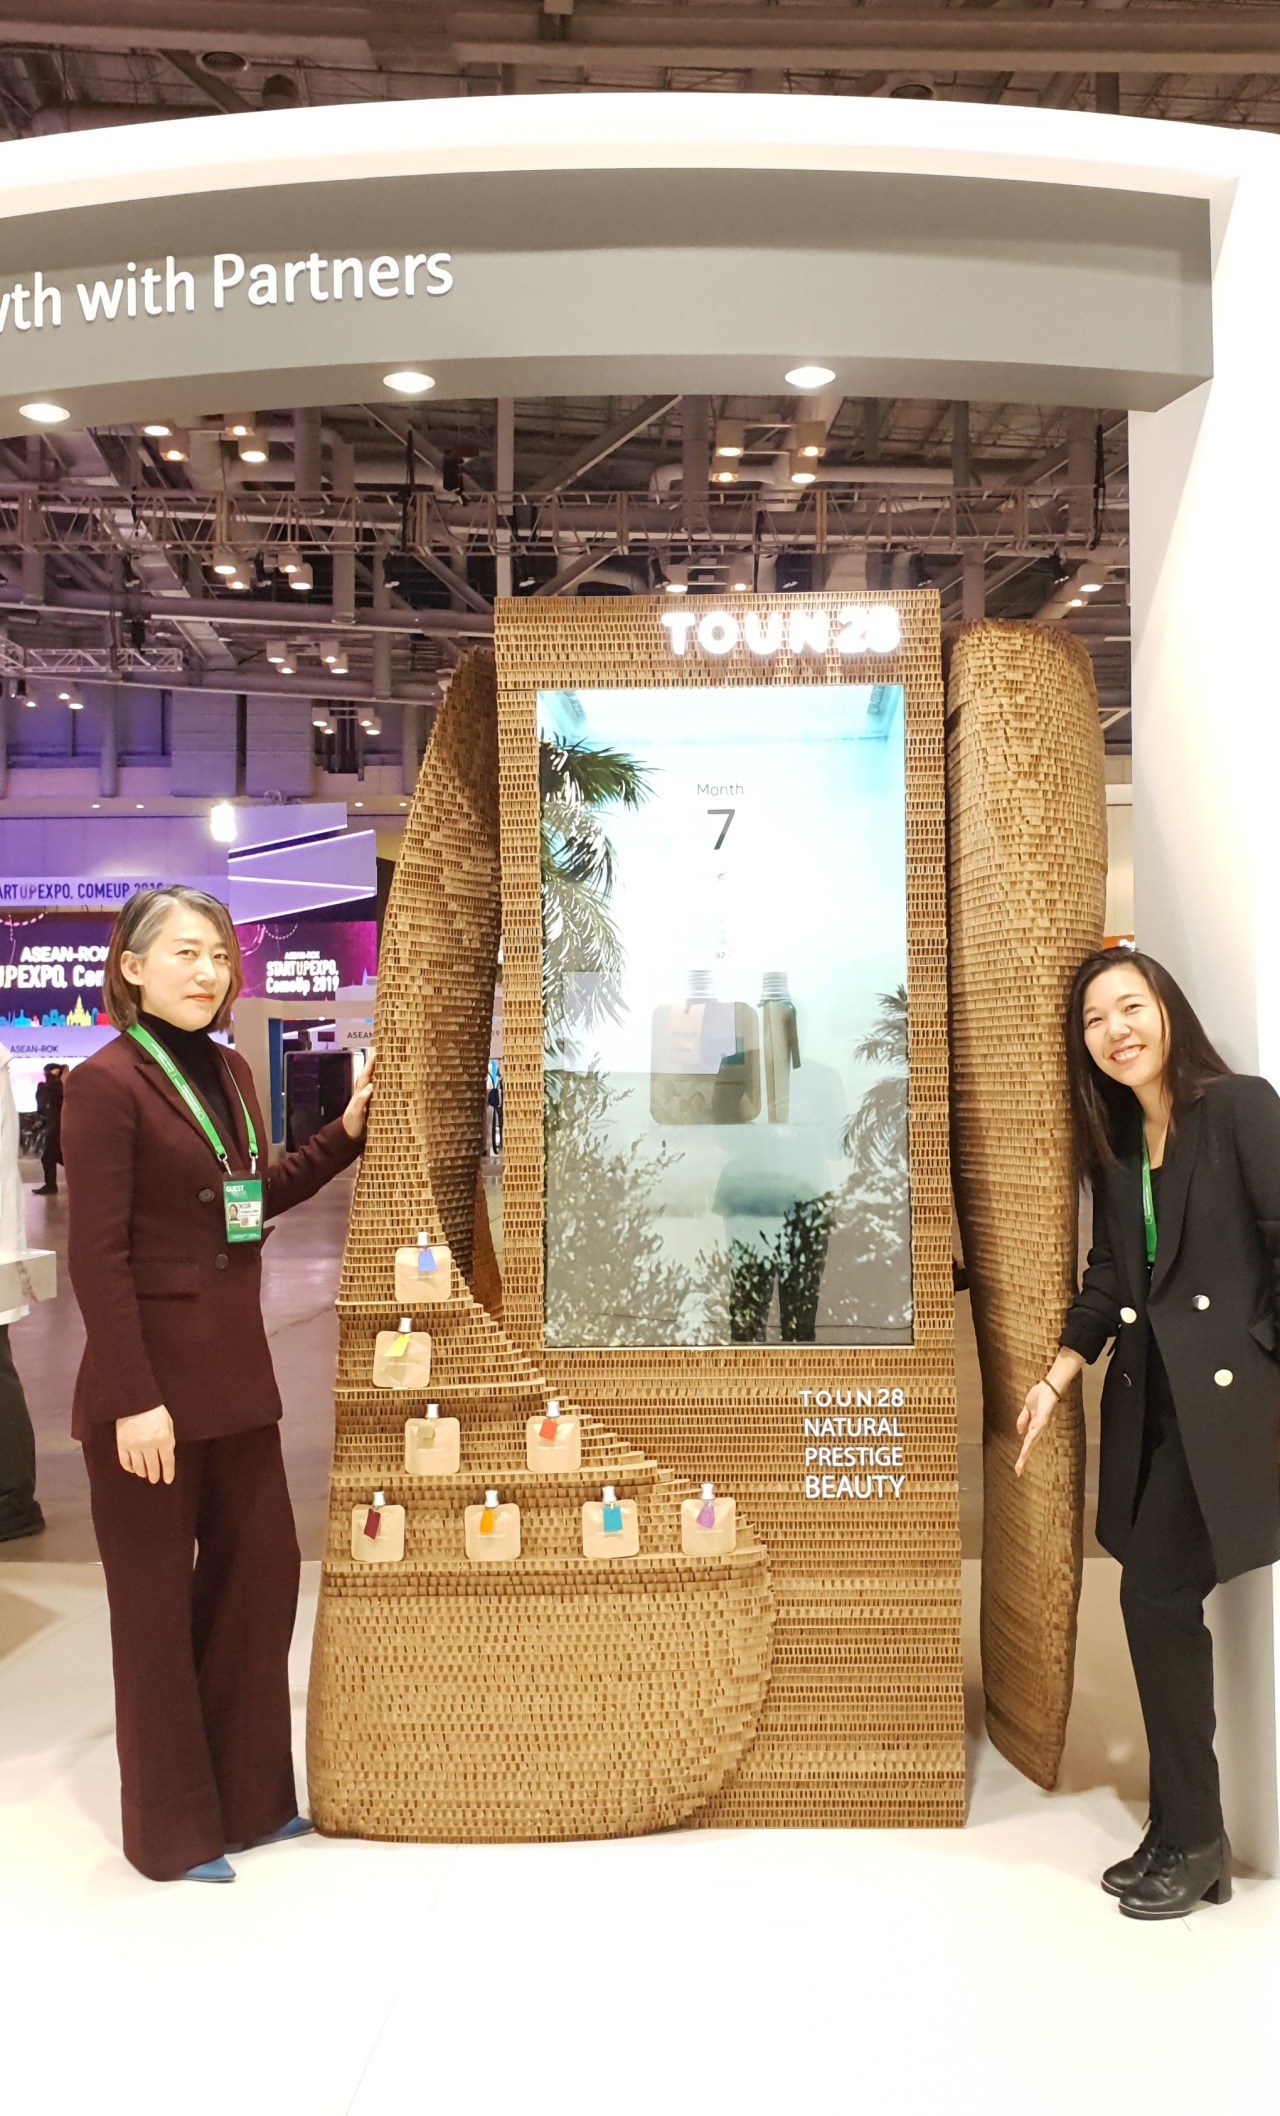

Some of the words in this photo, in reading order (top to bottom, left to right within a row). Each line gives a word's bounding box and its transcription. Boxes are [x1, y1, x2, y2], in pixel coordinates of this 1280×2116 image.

[0, 271, 62, 332] th
[76, 256, 195, 322] with
[213, 252, 454, 309] Partners
[661, 605, 900, 655] TOUN28
[697, 783, 744, 796] Month
[707, 809, 736, 851] 7
[78, 883, 130, 898] COMEUP
[20, 946, 110, 963] ASEAN-ROK
[313, 975, 340, 992] 2019
[10, 1045, 58, 1053] ASEAN-ROK
[225, 1185, 244, 1193] GUEST
[804, 1417, 905, 1438] NATURAL
[805, 1447, 904, 1467] PRESTIGE
[805, 1475, 906, 1499] BEAUTY
